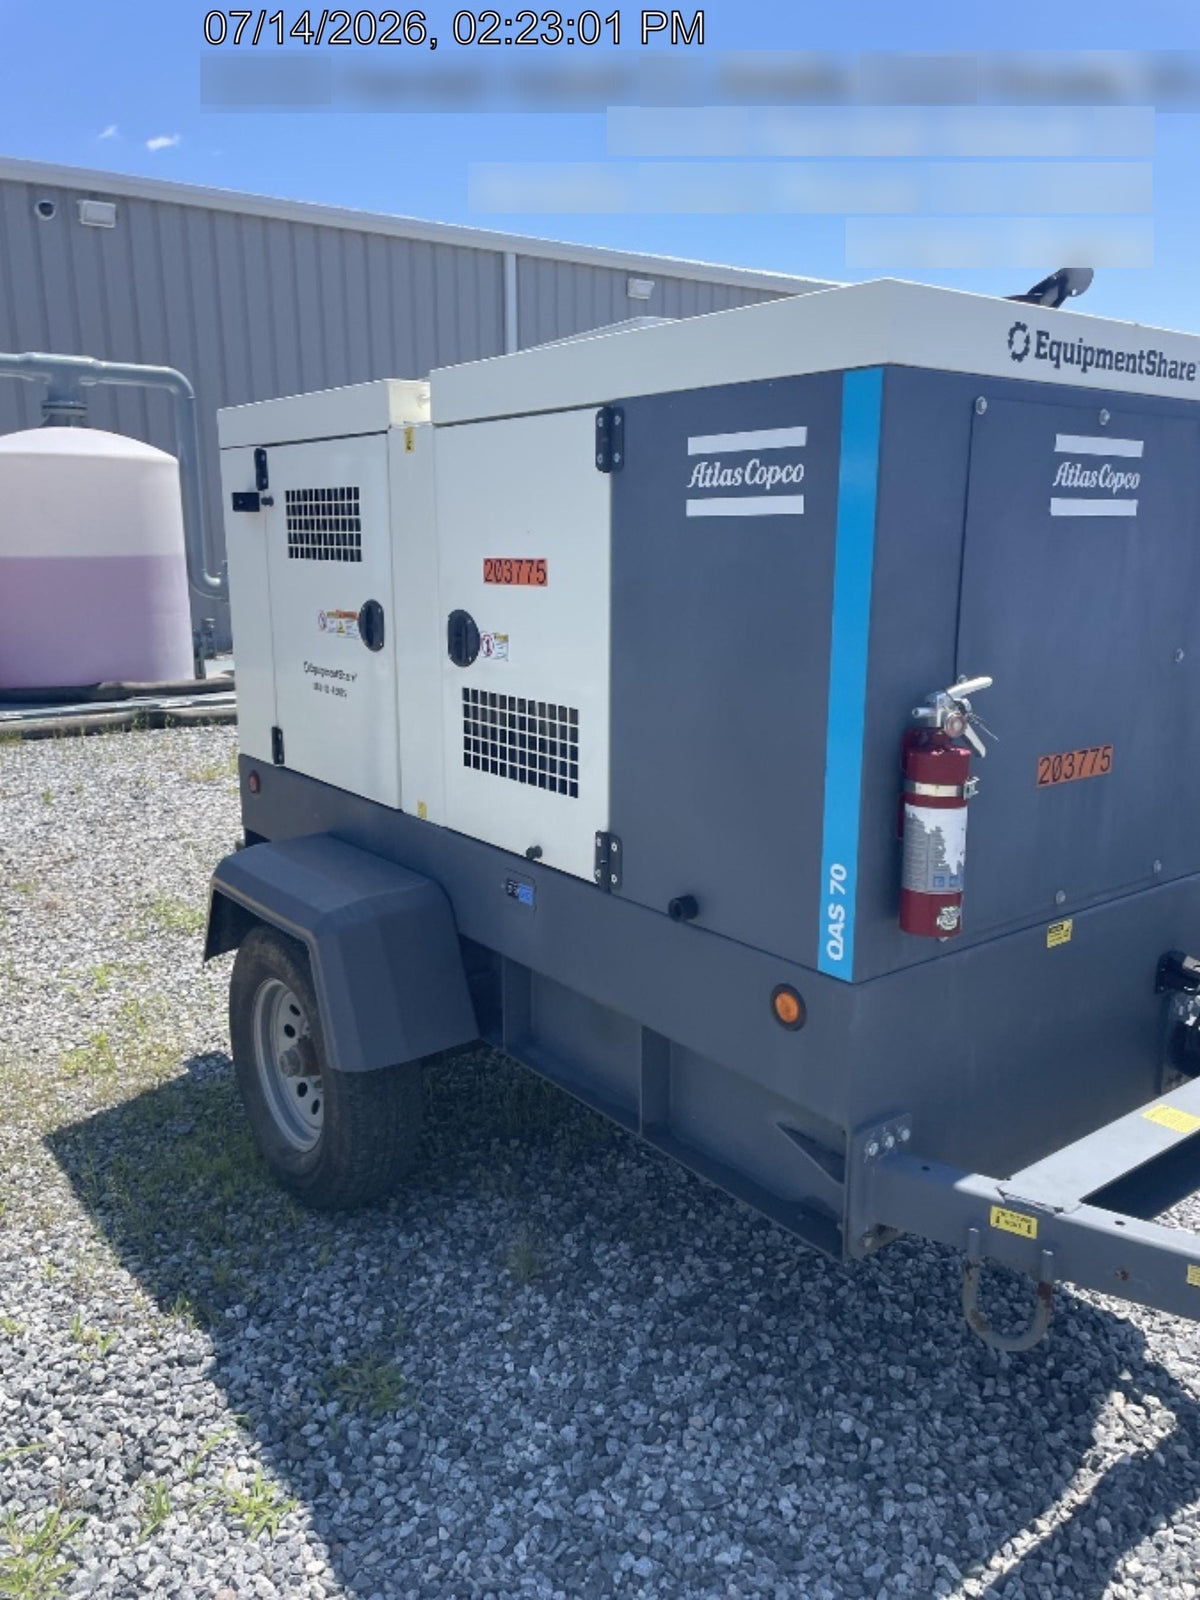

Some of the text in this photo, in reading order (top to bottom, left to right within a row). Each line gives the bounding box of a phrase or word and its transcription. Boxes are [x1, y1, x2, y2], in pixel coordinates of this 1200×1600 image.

[1034, 330, 1197, 382] EquipmentShare
[483, 558, 547, 585] 203775
[1037, 746, 1112, 786] 203775
[829, 863, 848, 896] 70
